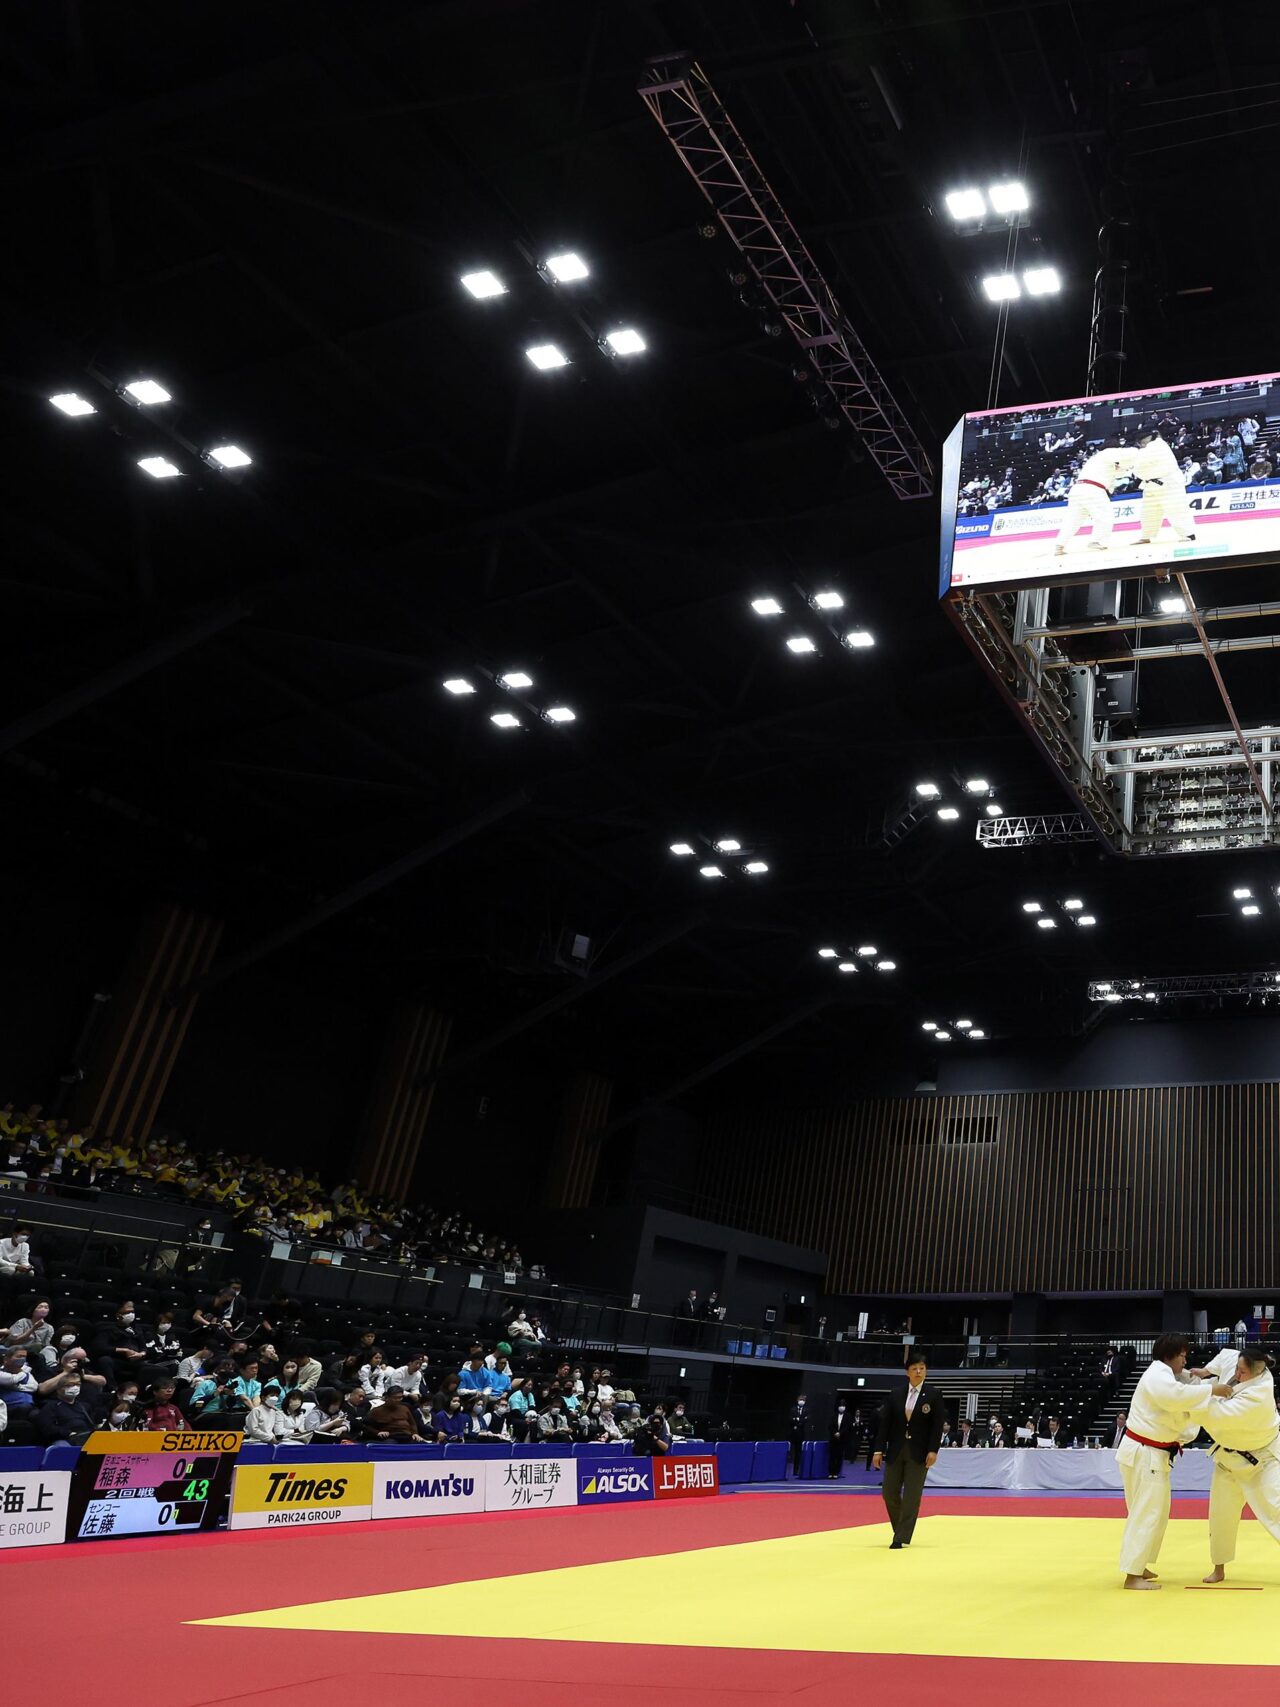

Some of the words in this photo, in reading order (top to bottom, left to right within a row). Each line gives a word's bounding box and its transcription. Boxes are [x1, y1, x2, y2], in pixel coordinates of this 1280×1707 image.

[1189, 497, 1220, 510] AL
[160, 1432, 238, 1452] SEIKO
[98, 1466, 132, 1487] 稲森
[172, 1458, 187, 1479] 0
[503, 1462, 562, 1487] 大和証券
[659, 1463, 715, 1490] 上月財団
[105, 1487, 156, 1499] 2回戦
[183, 1479, 209, 1500] 43
[264, 1472, 348, 1502] Times
[385, 1473, 475, 1500] KOMATSU
[596, 1473, 650, 1493] ALSOK
[0, 1483, 54, 1513] 海上
[511, 1485, 556, 1506] グループ
[89, 1503, 121, 1513] センコー
[157, 1504, 172, 1525] 0
[267, 1511, 306, 1524] PARK24
[307, 1509, 342, 1522] GROUP
[9, 1521, 51, 1536] GROUP
[82, 1513, 117, 1535] 佐藤
